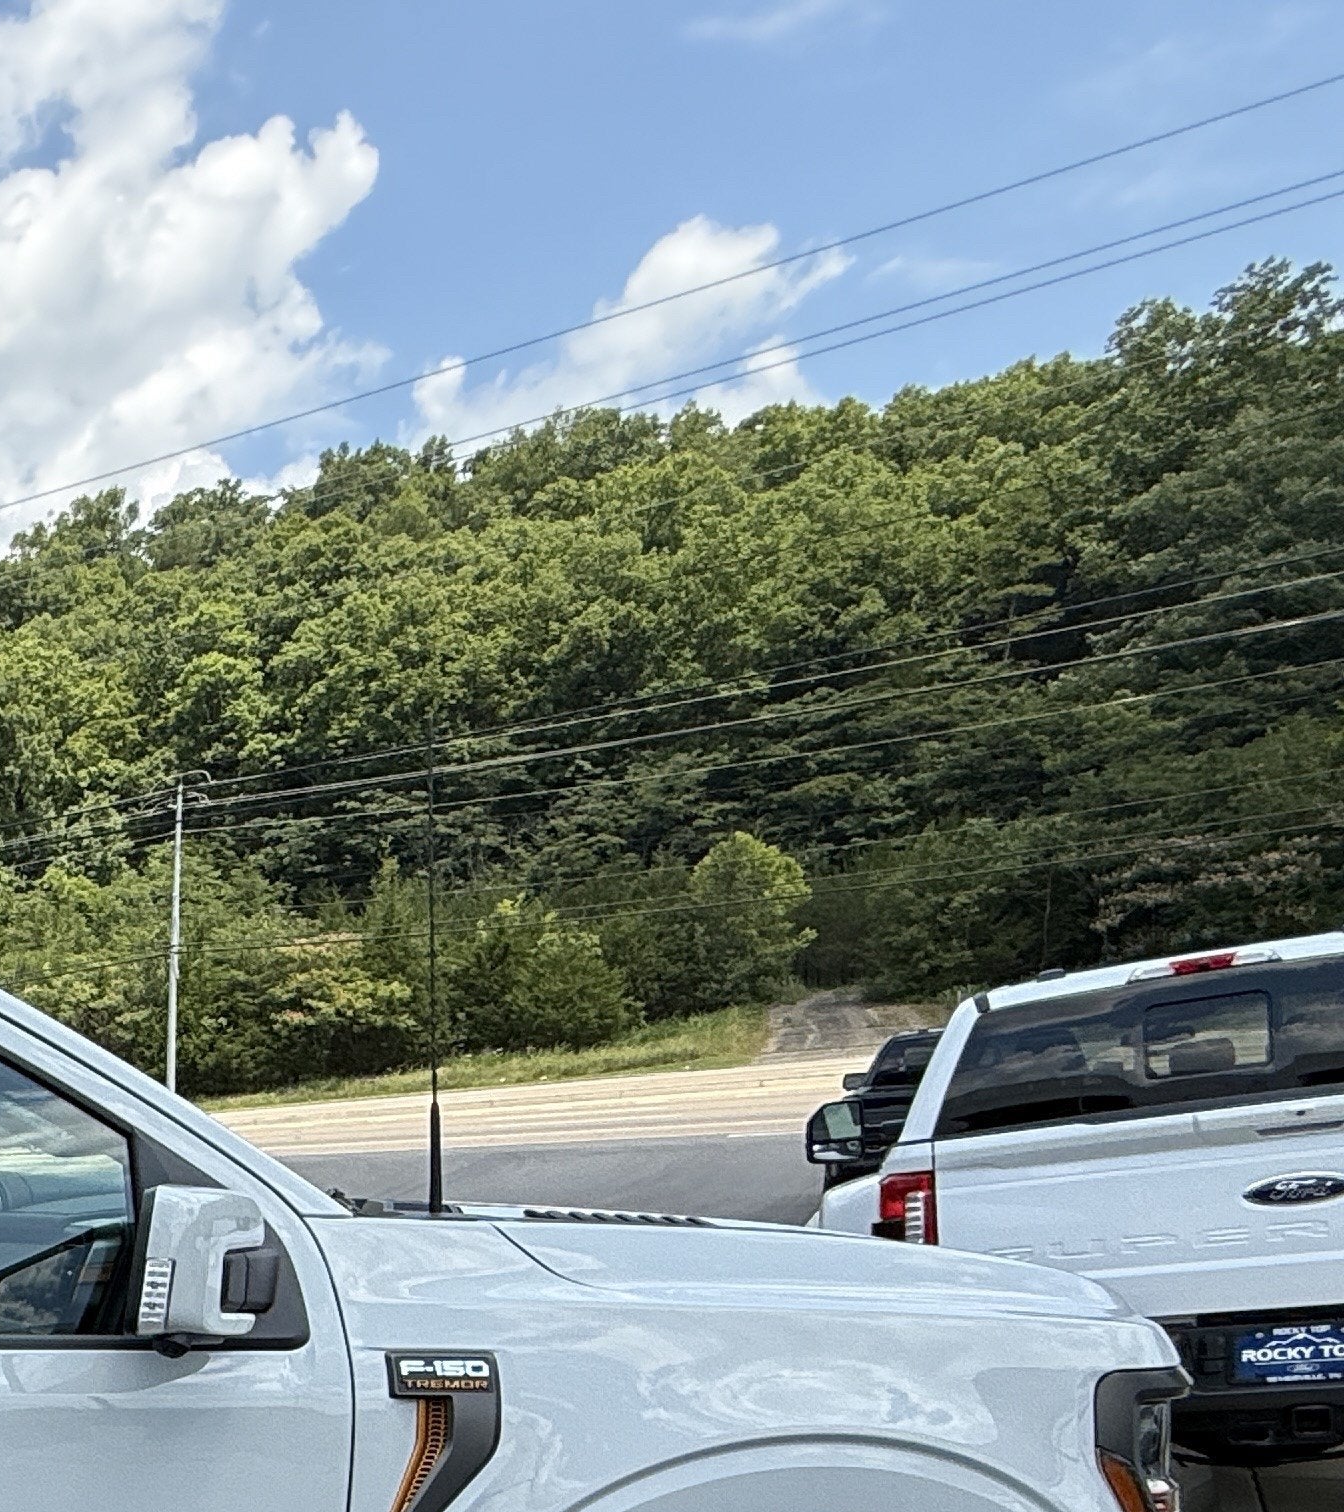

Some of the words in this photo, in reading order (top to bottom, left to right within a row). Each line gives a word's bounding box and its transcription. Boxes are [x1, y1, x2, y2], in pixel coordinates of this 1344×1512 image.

[1269, 1178, 1333, 1200] Ford
[1241, 1346, 1315, 1362] ROCKY
[399, 1360, 490, 1377] F-150
[404, 1379, 488, 1390] TREMOR
